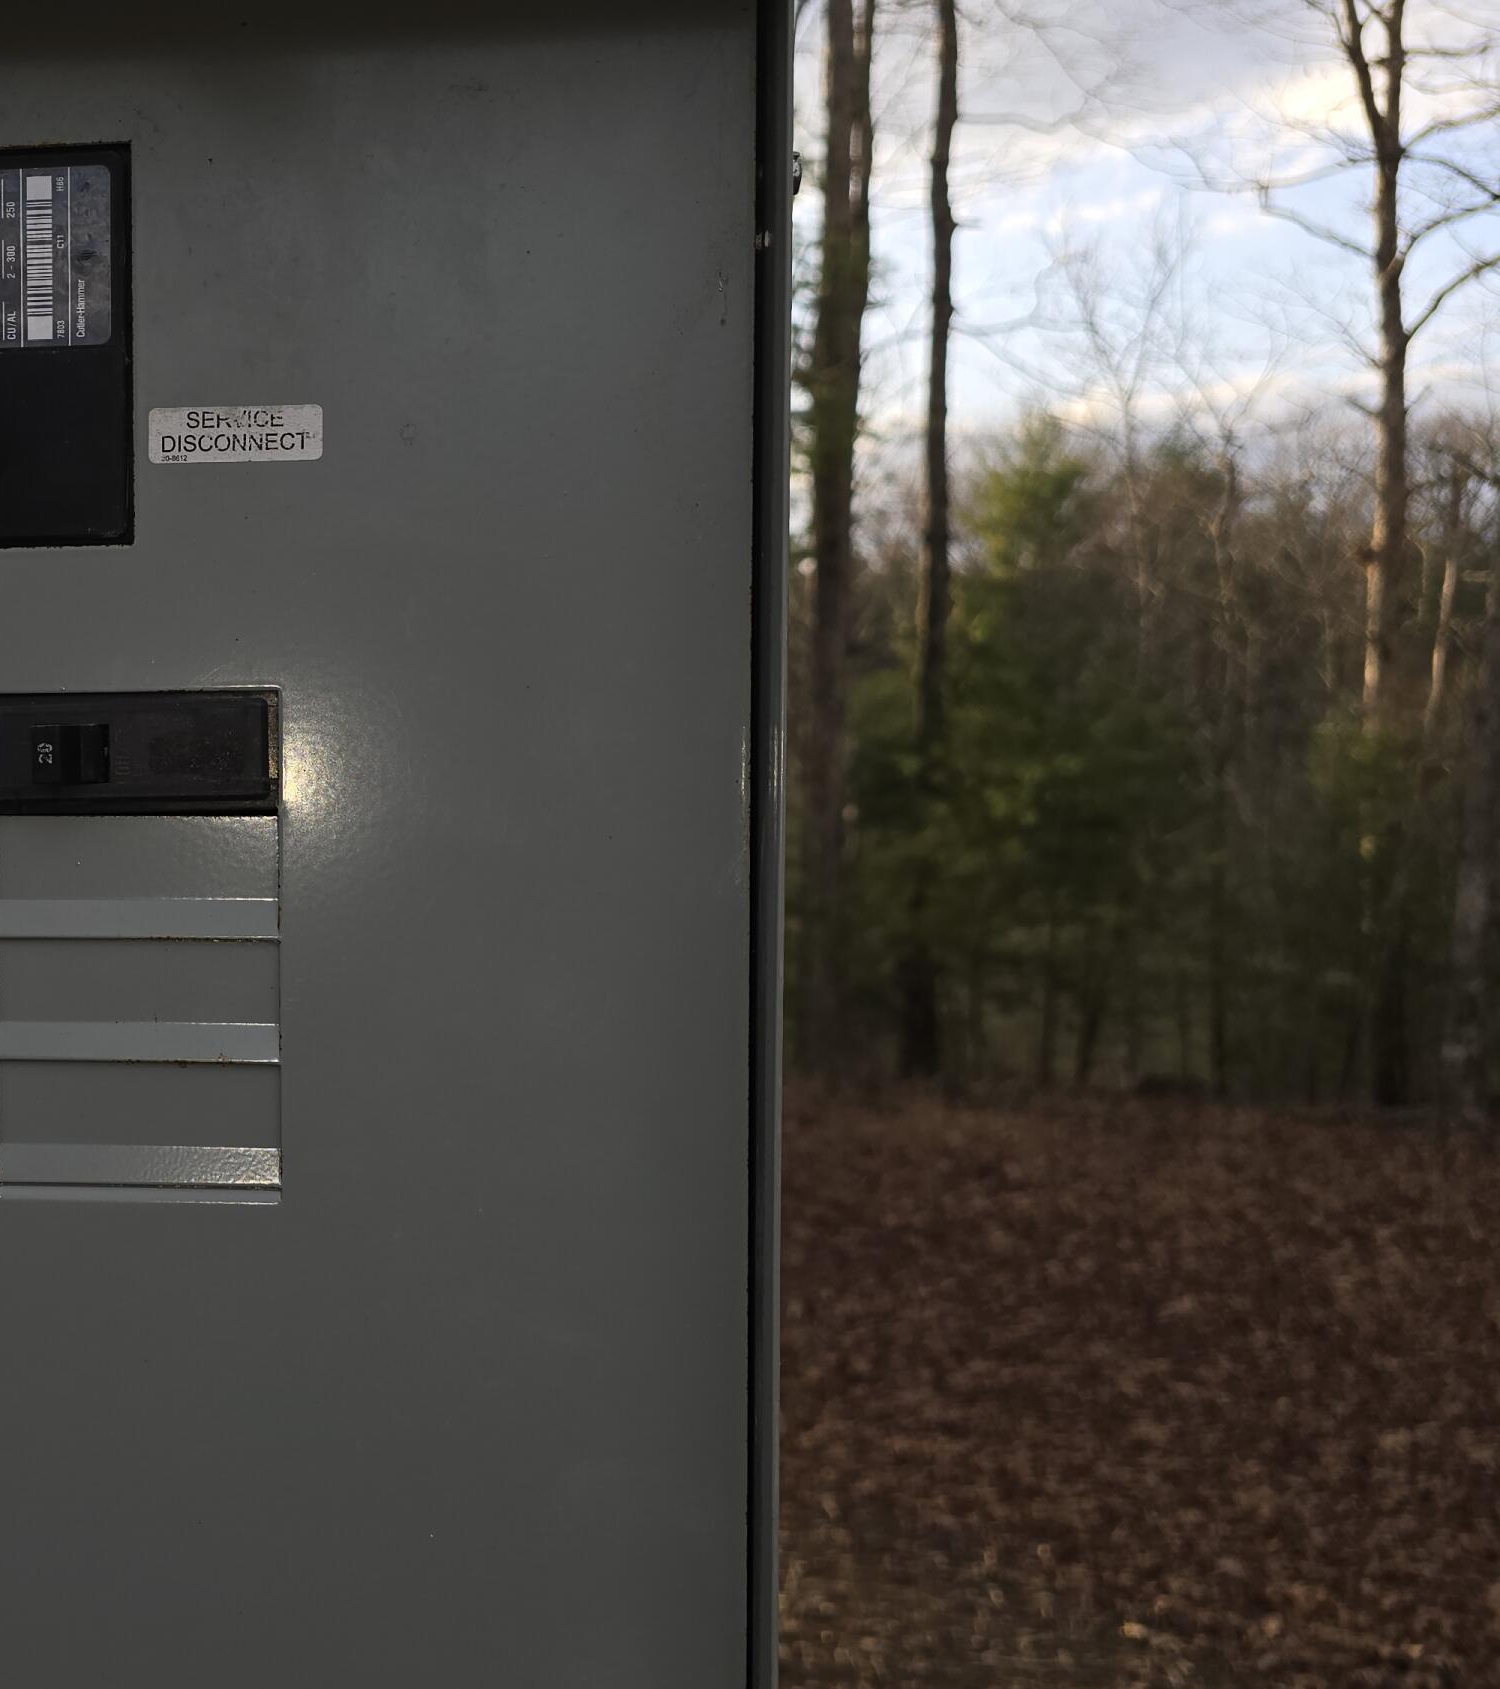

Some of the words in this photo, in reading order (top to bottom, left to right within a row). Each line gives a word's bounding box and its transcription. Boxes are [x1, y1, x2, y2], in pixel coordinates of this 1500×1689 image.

[6, 202, 16, 218] 250
[7, 245, 16, 262] 300
[76, 279, 86, 337] Cutler-Hammer
[7, 311, 16, 340] CU/AL
[57, 320, 65, 338] 7803
[187, 410, 283, 428] SERVICE
[162, 432, 307, 452] DISCONNECT
[37, 742, 52, 765] 20
